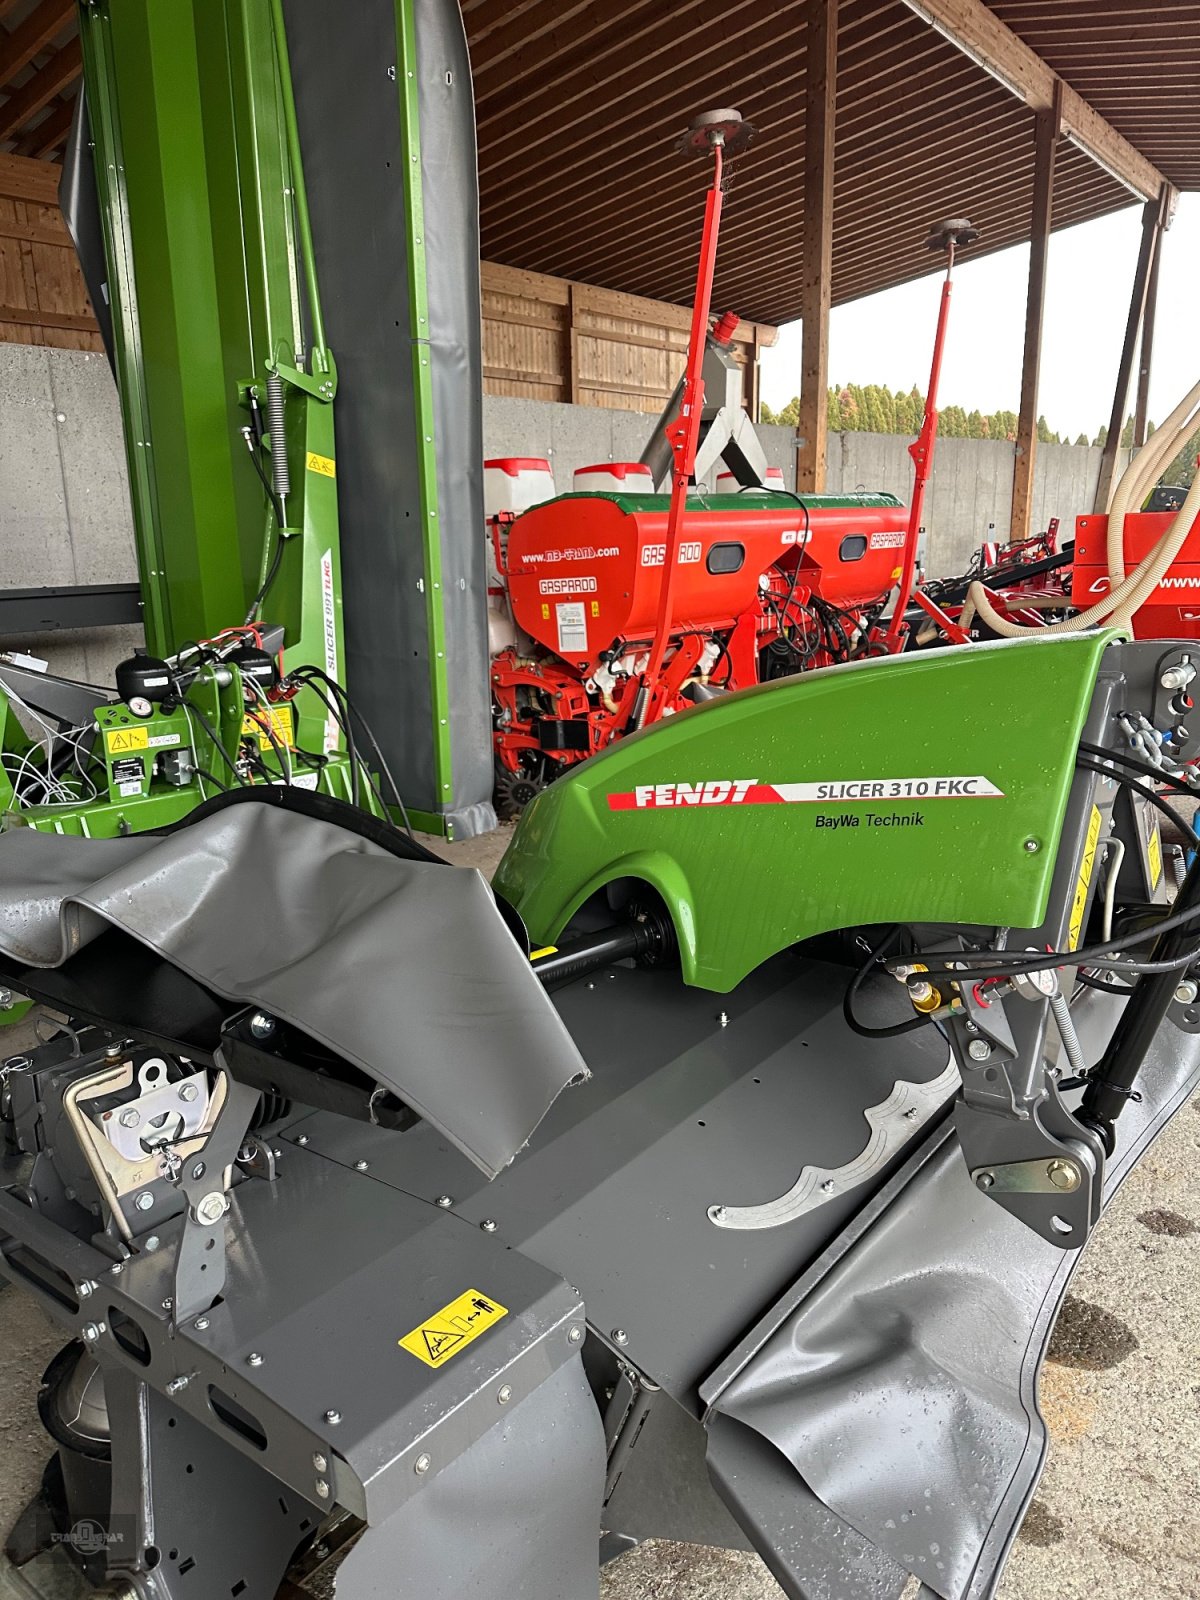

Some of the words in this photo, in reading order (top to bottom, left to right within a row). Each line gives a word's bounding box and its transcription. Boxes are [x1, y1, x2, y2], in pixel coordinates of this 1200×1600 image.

[540, 578, 596, 593] GASPARDO
[326, 618, 335, 671] SLICER
[635, 779, 759, 807] FENDT
[816, 784, 884, 799] SLICER
[889, 782, 928, 797] 310
[934, 780, 978, 795] FKC
[815, 815, 860, 828] BayWa
[866, 813, 925, 827] Technik
